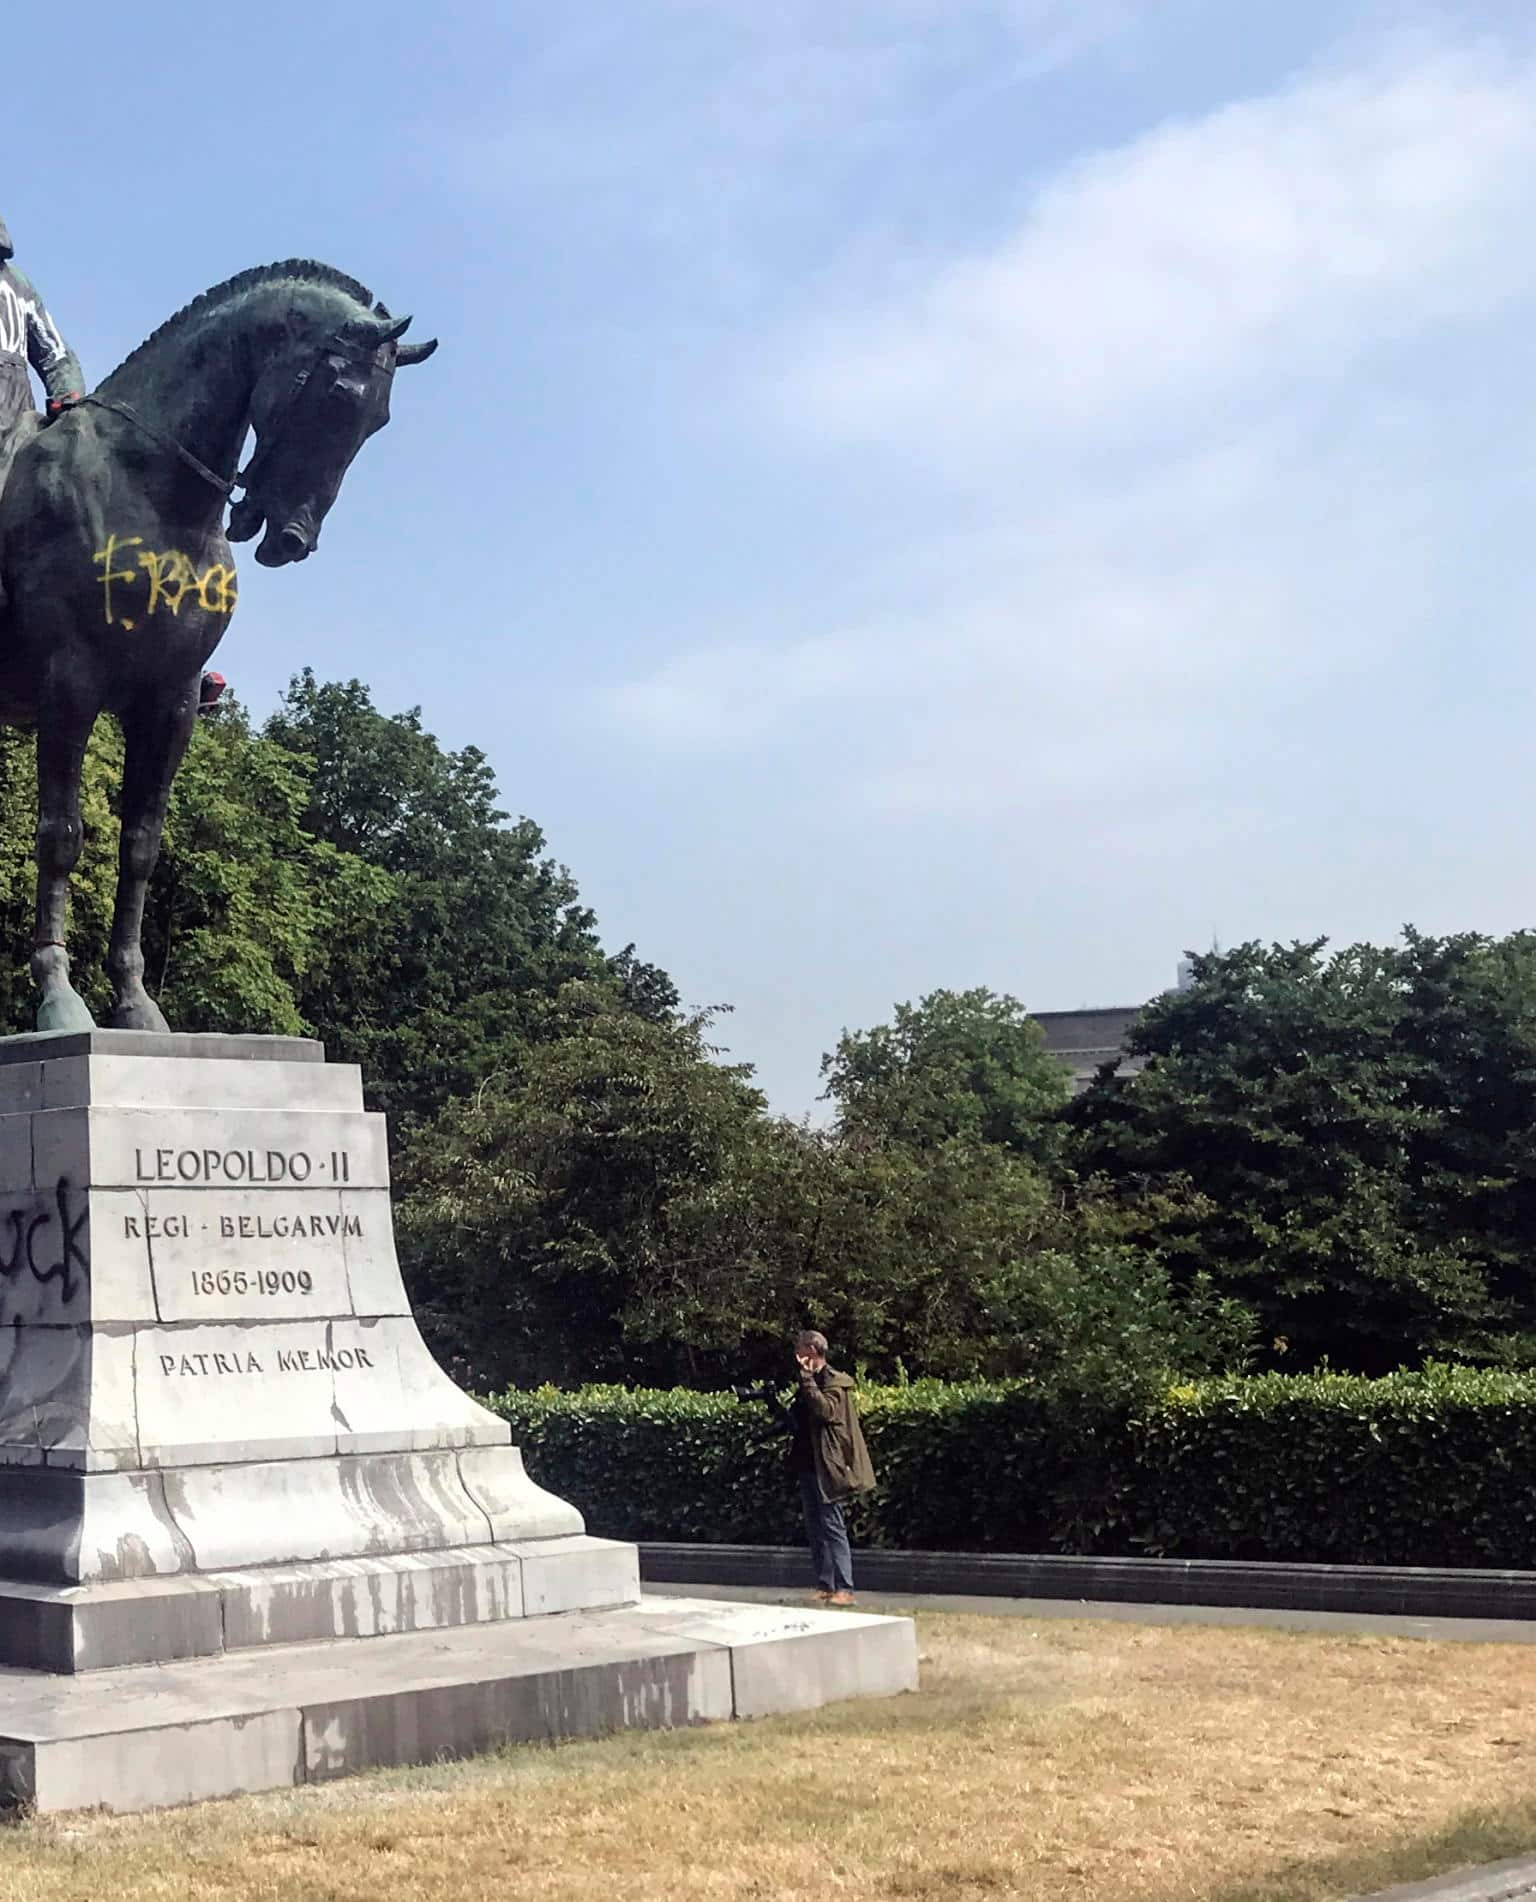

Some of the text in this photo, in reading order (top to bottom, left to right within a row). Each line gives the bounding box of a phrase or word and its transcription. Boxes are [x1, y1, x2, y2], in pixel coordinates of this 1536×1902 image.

[135, 1148, 312, 1182] LEOPOLDO
[124, 1215, 363, 1239] REGI BELGARVM
[160, 1347, 374, 1376] PATRIA MEMOR
